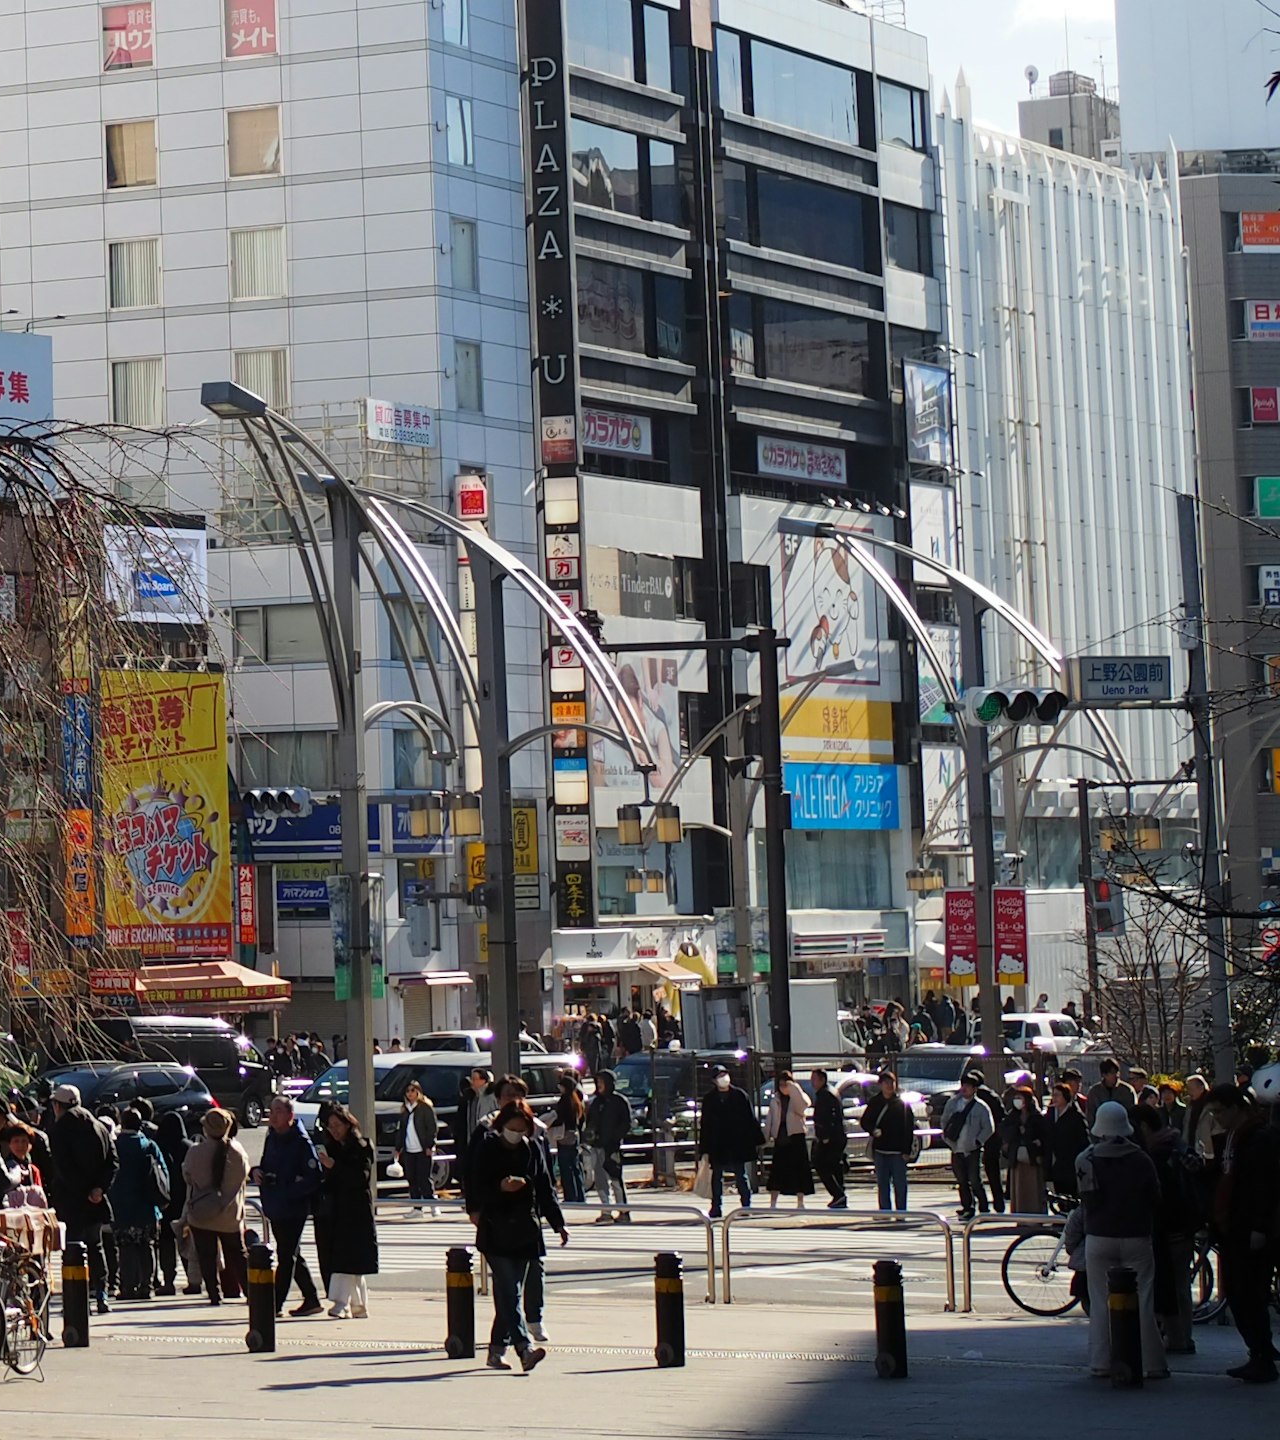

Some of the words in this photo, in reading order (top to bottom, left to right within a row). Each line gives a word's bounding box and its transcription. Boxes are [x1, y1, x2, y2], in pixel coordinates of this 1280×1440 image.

[232, 26, 275, 50] メイト
[530, 57, 563, 260] PLAZA
[585, 411, 633, 446] カラオケ
[768, 445, 800, 469] カラオケ
[621, 573, 664, 595] TinderBAL
[1087, 662, 1163, 683] 上野公園前
[1102, 685, 1125, 695] Ueno
[1128, 685, 1149, 695] Park
[854, 775, 884, 793] アリシア
[855, 800, 892, 819] クリニック
[145, 831, 209, 882] チケット
[147, 883, 180, 897] SERVICE
[239, 866, 253, 925] 外貨両替
[949, 898, 974, 907] Hello
[997, 897, 1022, 907] Hello
[949, 908, 970, 920] Kitty
[998, 906, 1019, 920] Kitty
[130, 927, 175, 944] EXCHANGE
